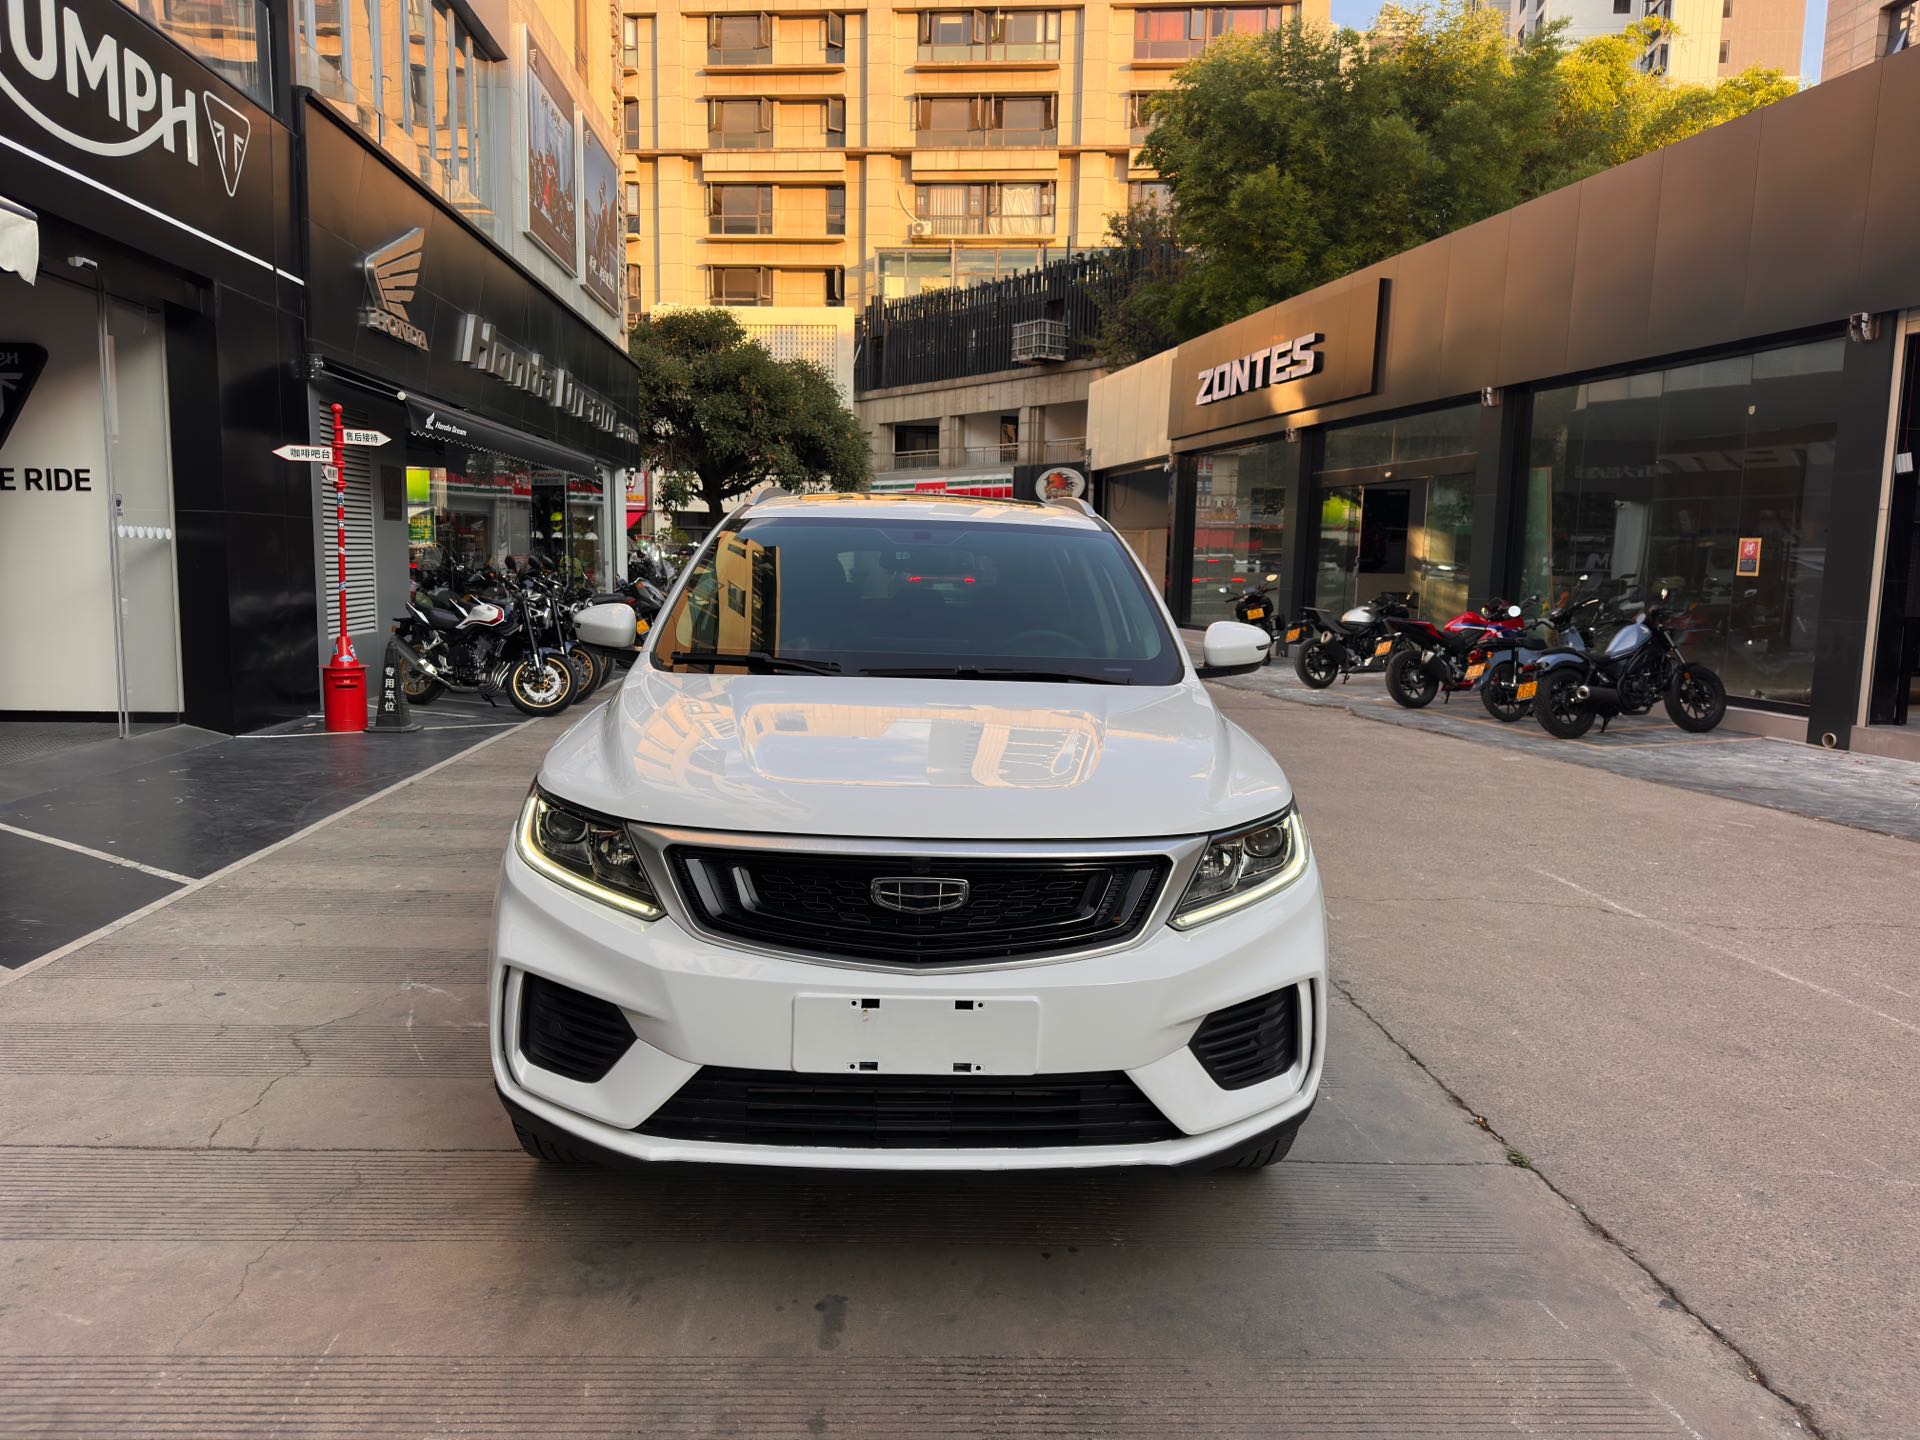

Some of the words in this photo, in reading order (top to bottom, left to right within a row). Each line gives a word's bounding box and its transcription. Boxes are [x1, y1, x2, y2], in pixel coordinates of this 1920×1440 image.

[0, 0, 198, 167] UMPH
[1196, 332, 1316, 406] ZONTES
[346, 431, 379, 443] 售后接待
[435, 421, 452, 433] Honda
[451, 425, 468, 437] Dream
[290, 448, 330, 459] 咖啡吧台
[25, 468, 92, 491] RIDE
[384, 666, 395, 712] 专用车位
